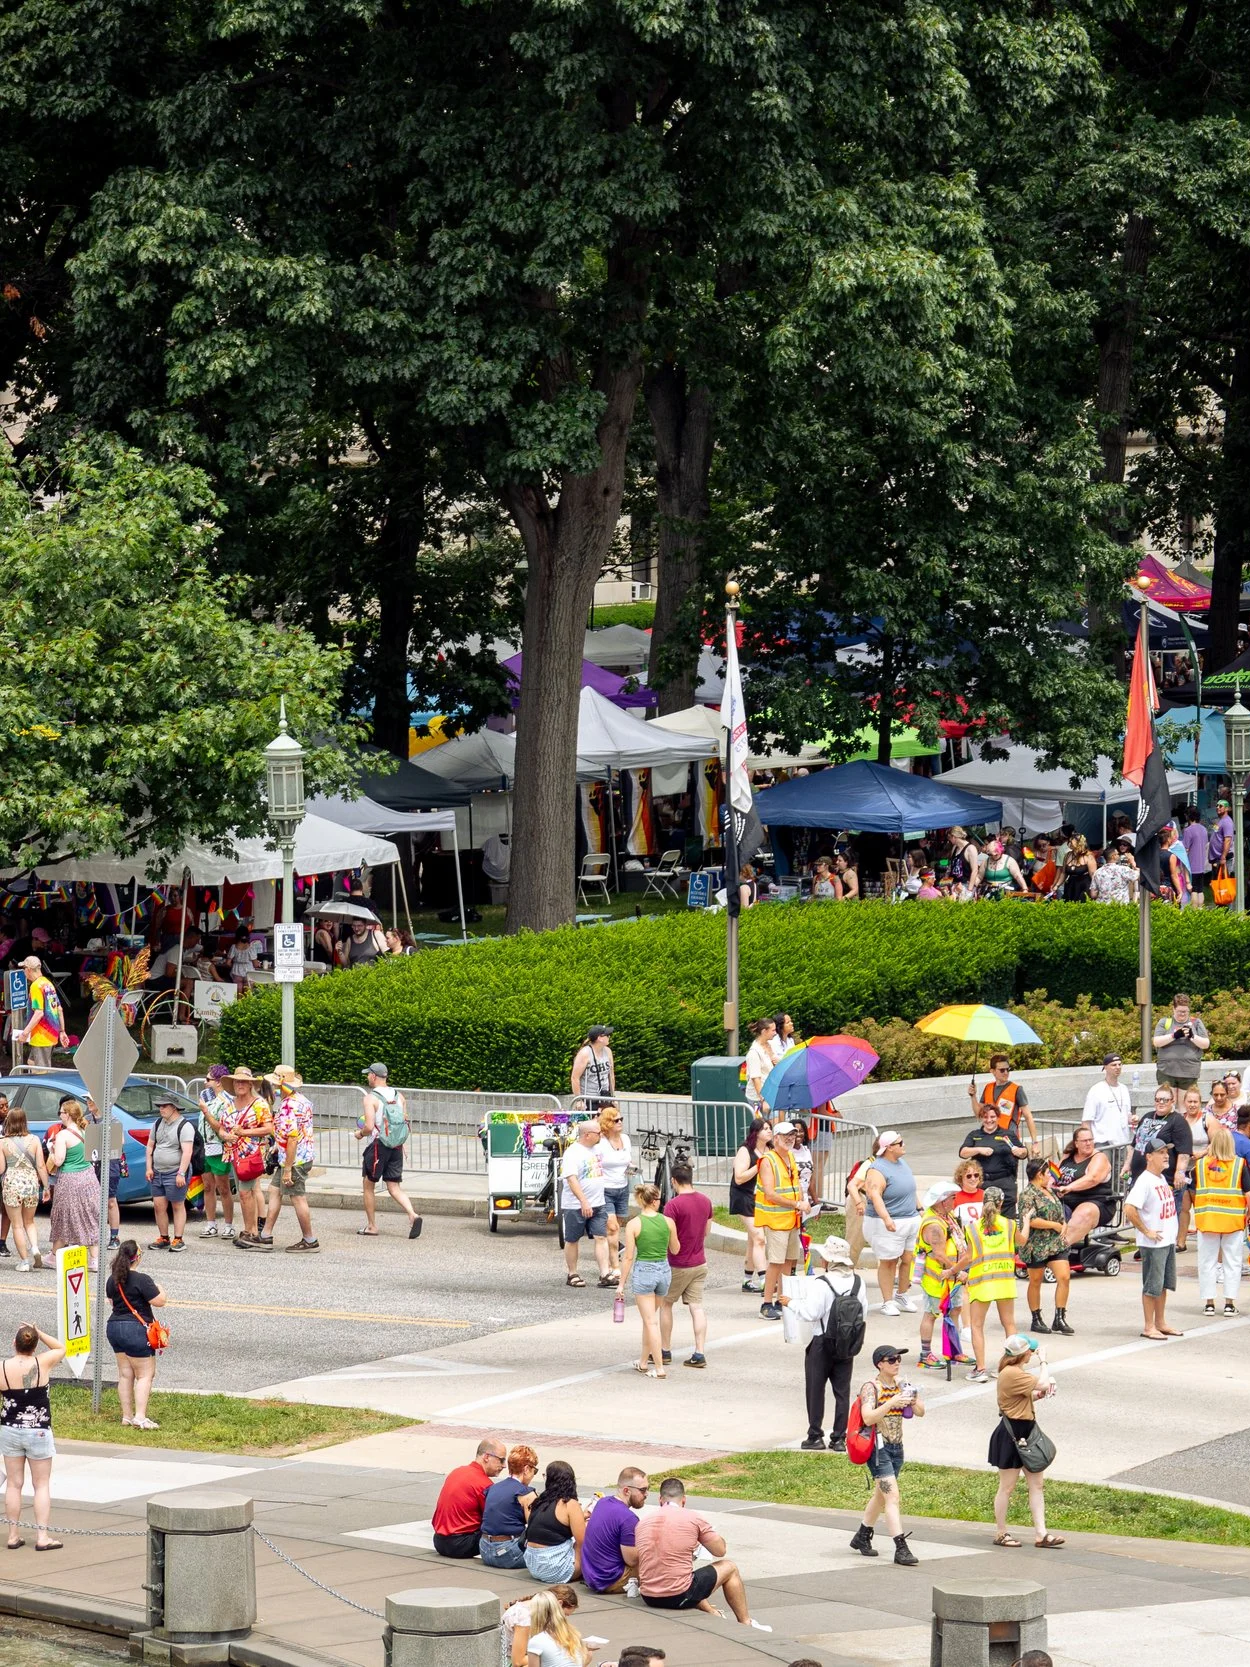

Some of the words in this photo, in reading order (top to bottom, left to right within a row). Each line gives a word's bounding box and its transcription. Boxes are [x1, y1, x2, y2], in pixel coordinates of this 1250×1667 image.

[67, 1249, 83, 1260] STATE
[69, 1259, 81, 1267] LAW
[982, 1260, 1013, 1273] CAPTAIN
